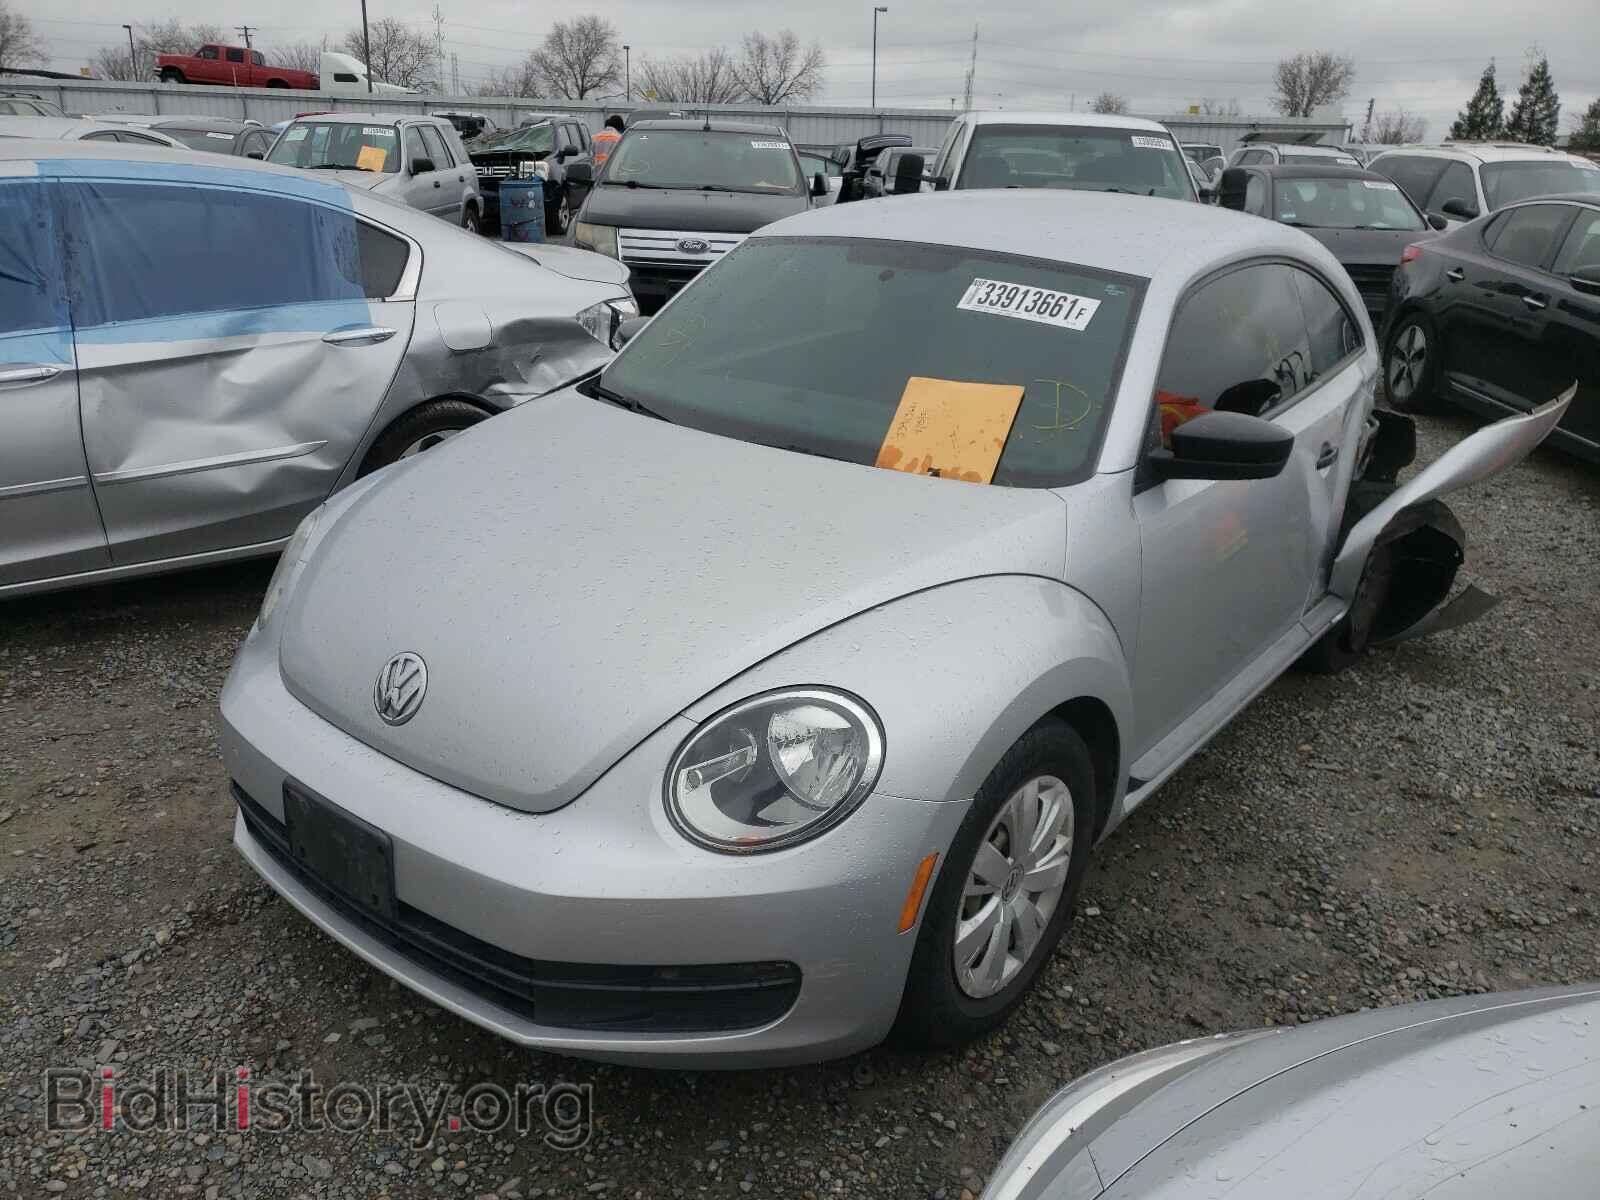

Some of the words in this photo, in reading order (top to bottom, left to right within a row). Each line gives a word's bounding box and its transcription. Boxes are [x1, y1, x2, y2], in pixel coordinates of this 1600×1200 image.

[681, 239, 704, 249] Ford
[977, 282, 1079, 321] 33913661
[1075, 307, 1088, 320] F
[375, 652, 427, 724] VW
